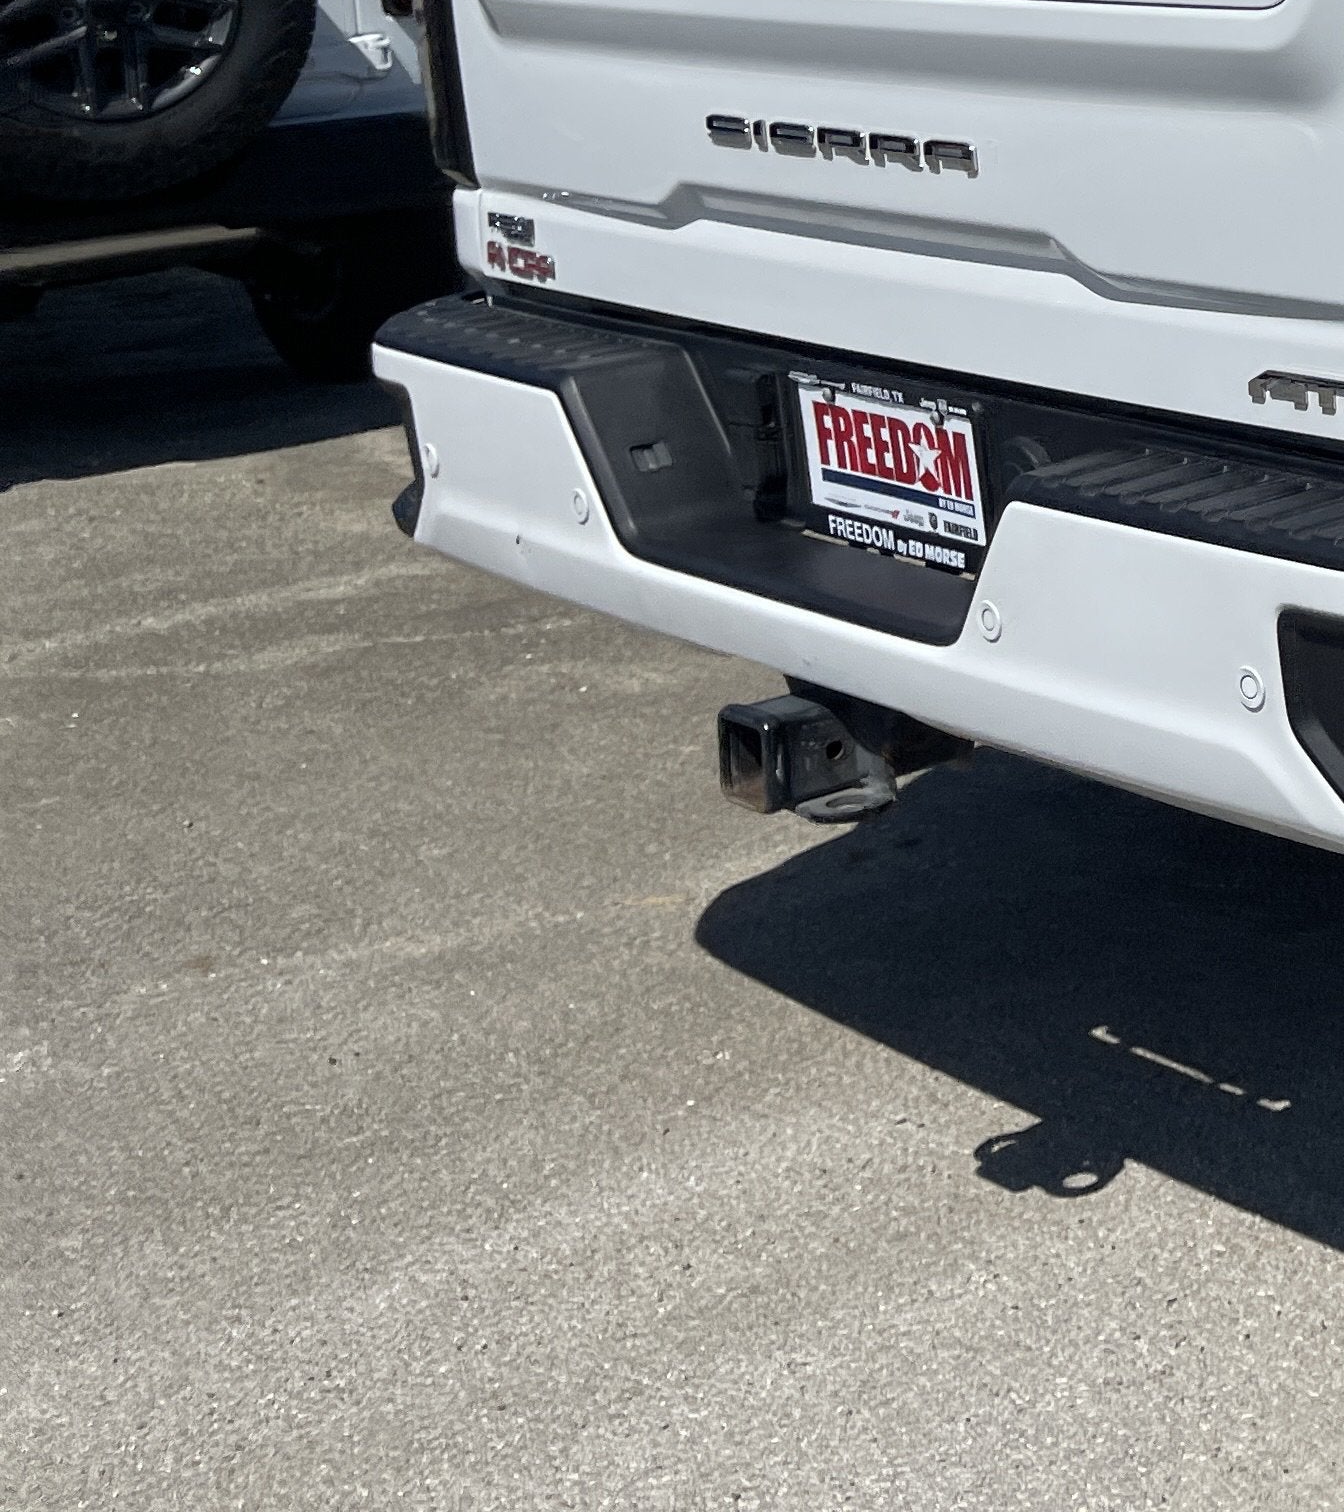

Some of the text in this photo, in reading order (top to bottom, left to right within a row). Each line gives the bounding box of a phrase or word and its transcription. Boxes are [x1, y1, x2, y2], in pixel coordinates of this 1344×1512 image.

[705, 113, 979, 178] SIERRA
[812, 400, 974, 501] FREEDOM
[828, 514, 895, 551] FREEDOM
[908, 541, 923, 558] ED
[924, 544, 966, 569] MORSE
